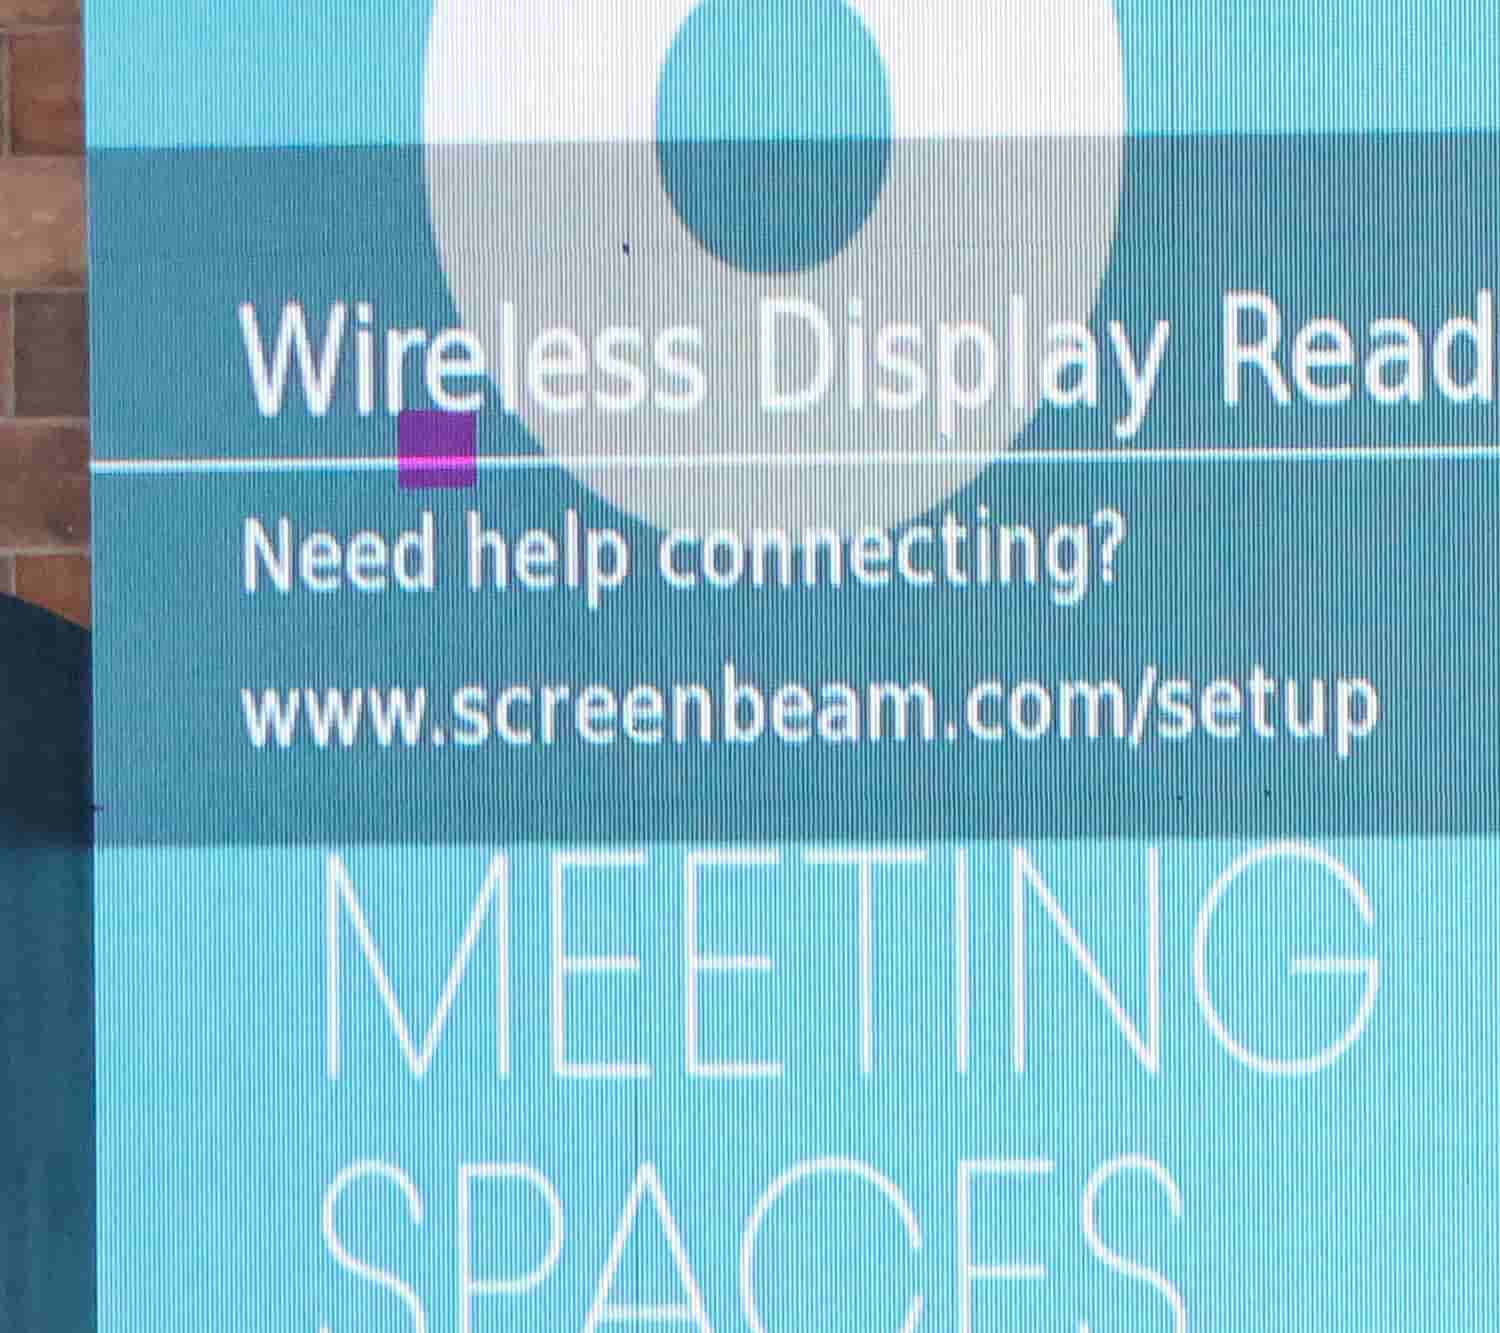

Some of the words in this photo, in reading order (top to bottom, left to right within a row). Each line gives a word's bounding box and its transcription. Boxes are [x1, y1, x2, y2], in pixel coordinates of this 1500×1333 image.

[242, 300, 707, 414] Wireless
[757, 293, 1170, 436] Display
[243, 513, 435, 592] Need
[466, 507, 630, 608] help
[656, 506, 1126, 605] connecting?
[241, 664, 1381, 758] www.screenbeam.com/setup
[325, 840, 1383, 1080] MEETING
